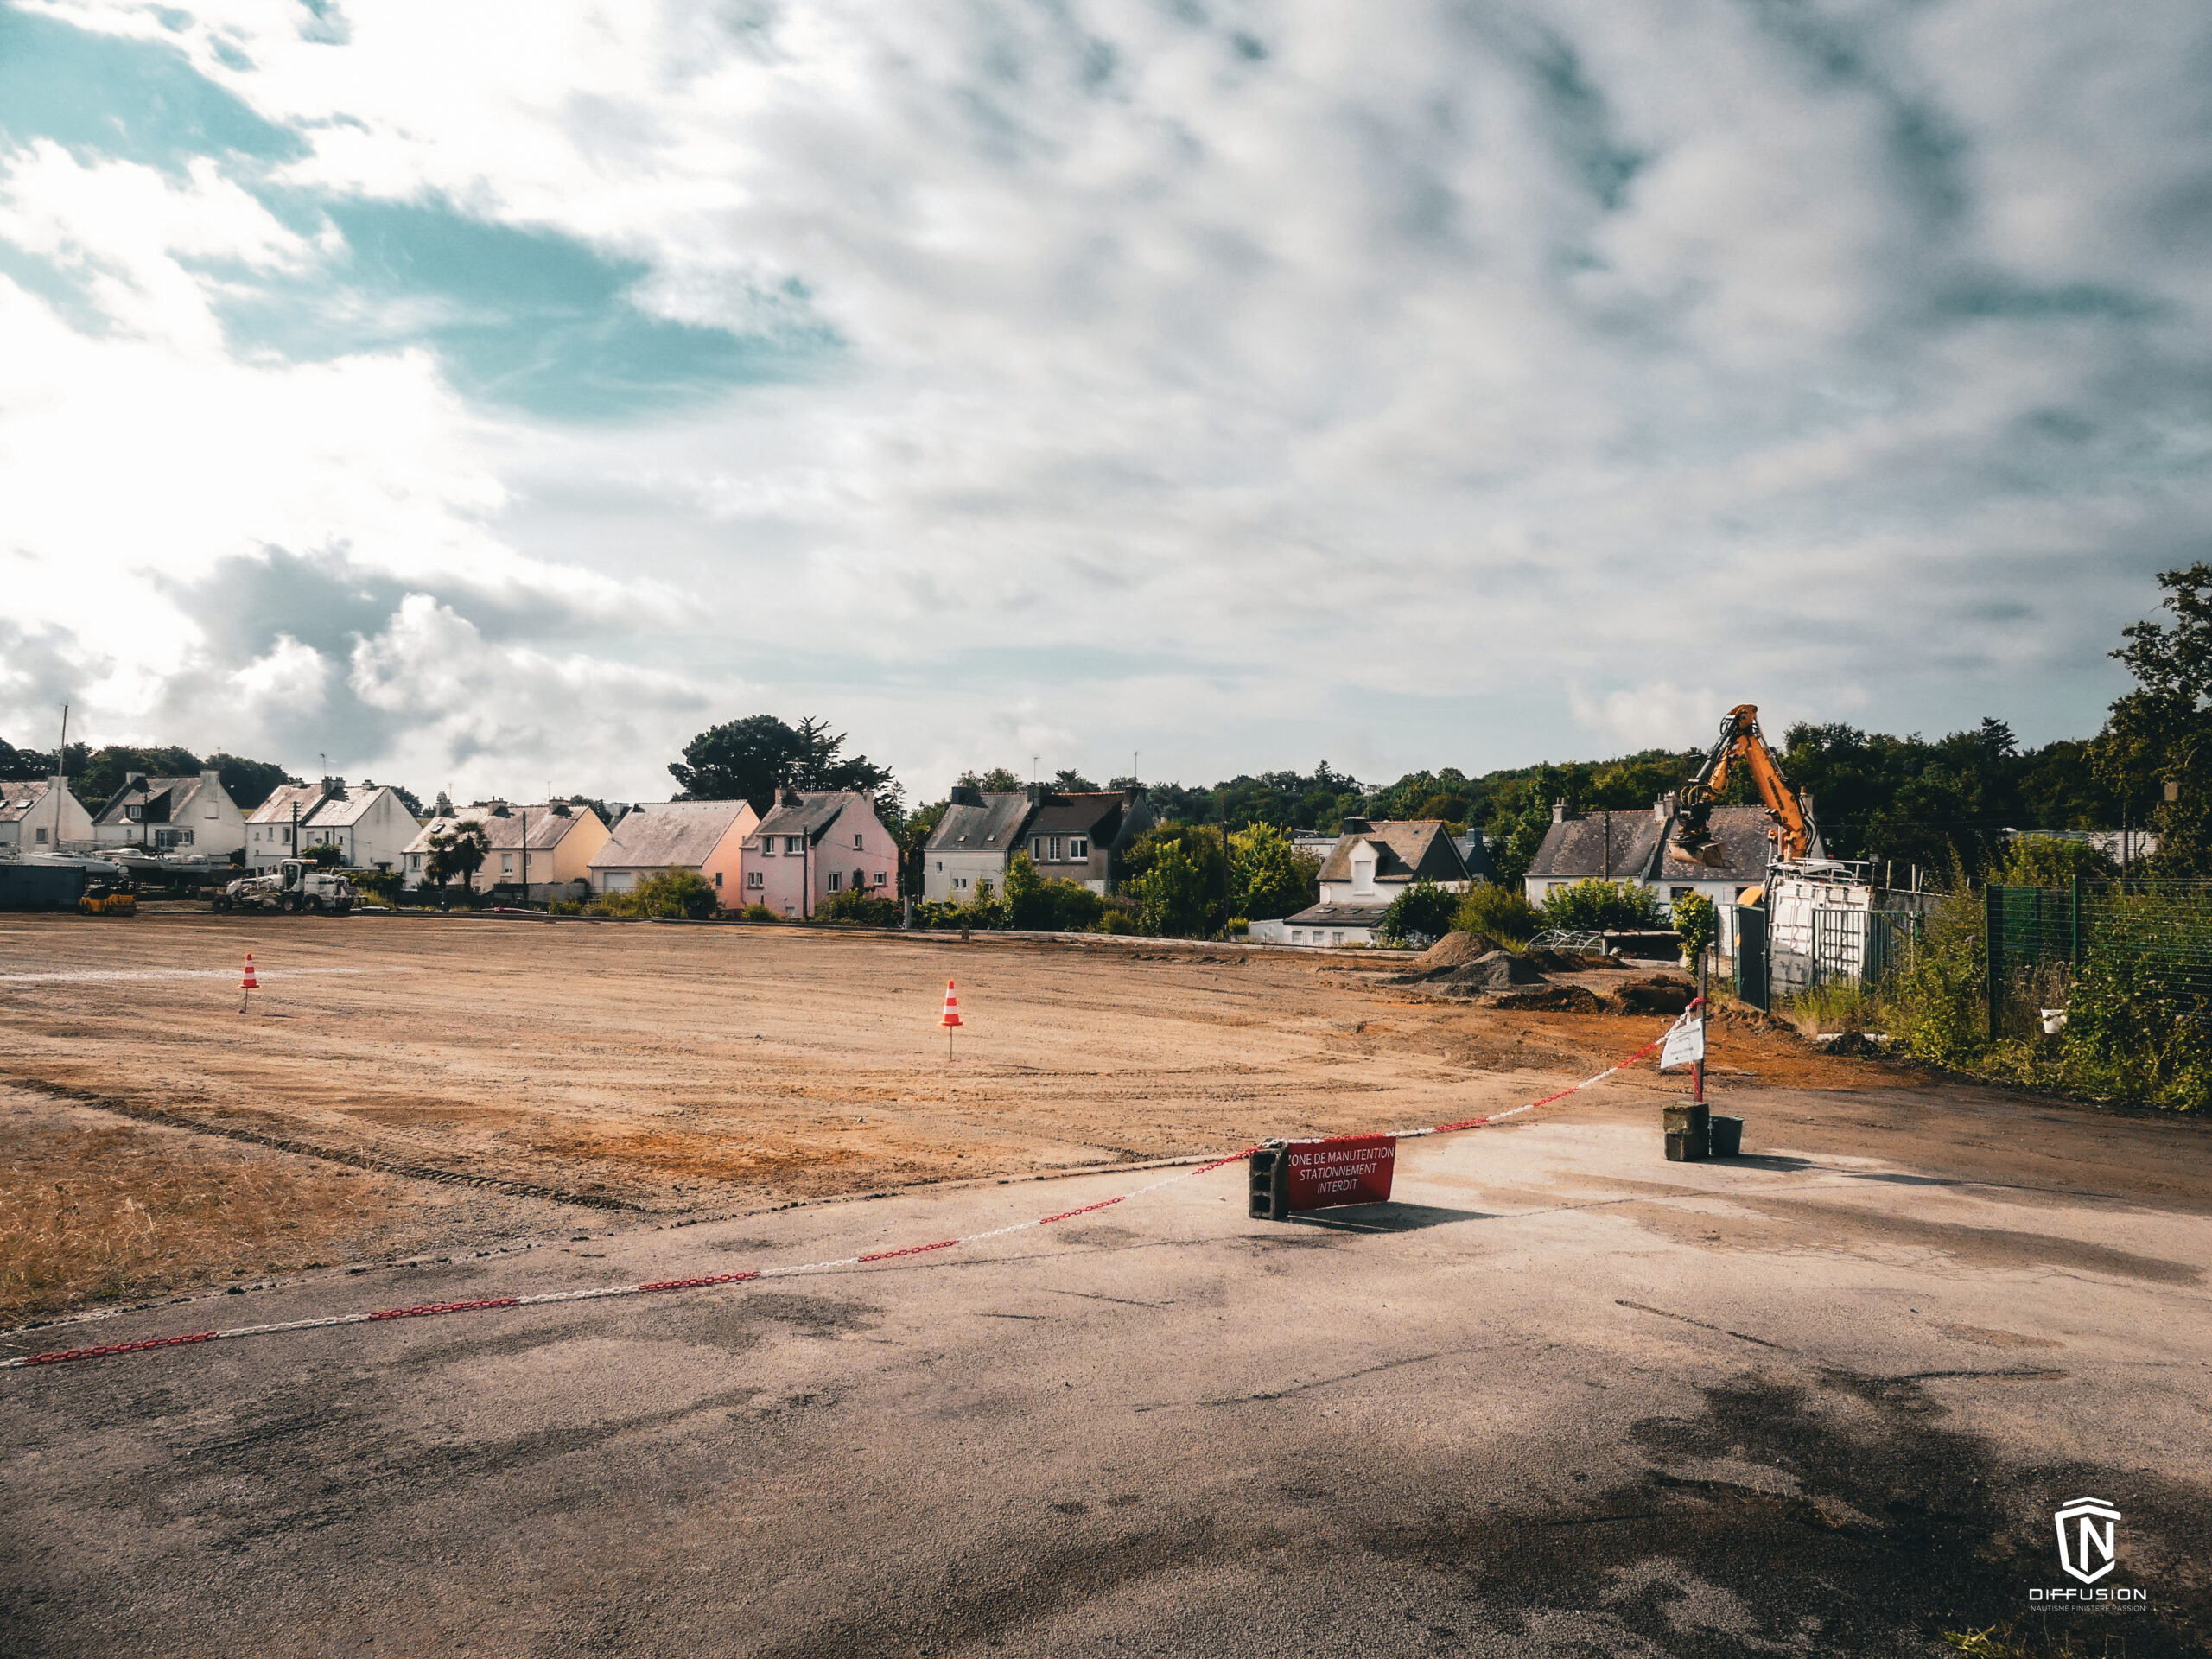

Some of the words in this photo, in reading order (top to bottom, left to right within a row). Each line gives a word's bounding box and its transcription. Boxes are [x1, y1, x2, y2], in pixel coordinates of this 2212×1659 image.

[1314, 1152, 1326, 1165] DE
[1327, 1147, 1395, 1163] MANUTENTION
[1300, 1162, 1377, 1181] STATIONNEMENT
[1317, 1179, 1358, 1194] INTERDIT
